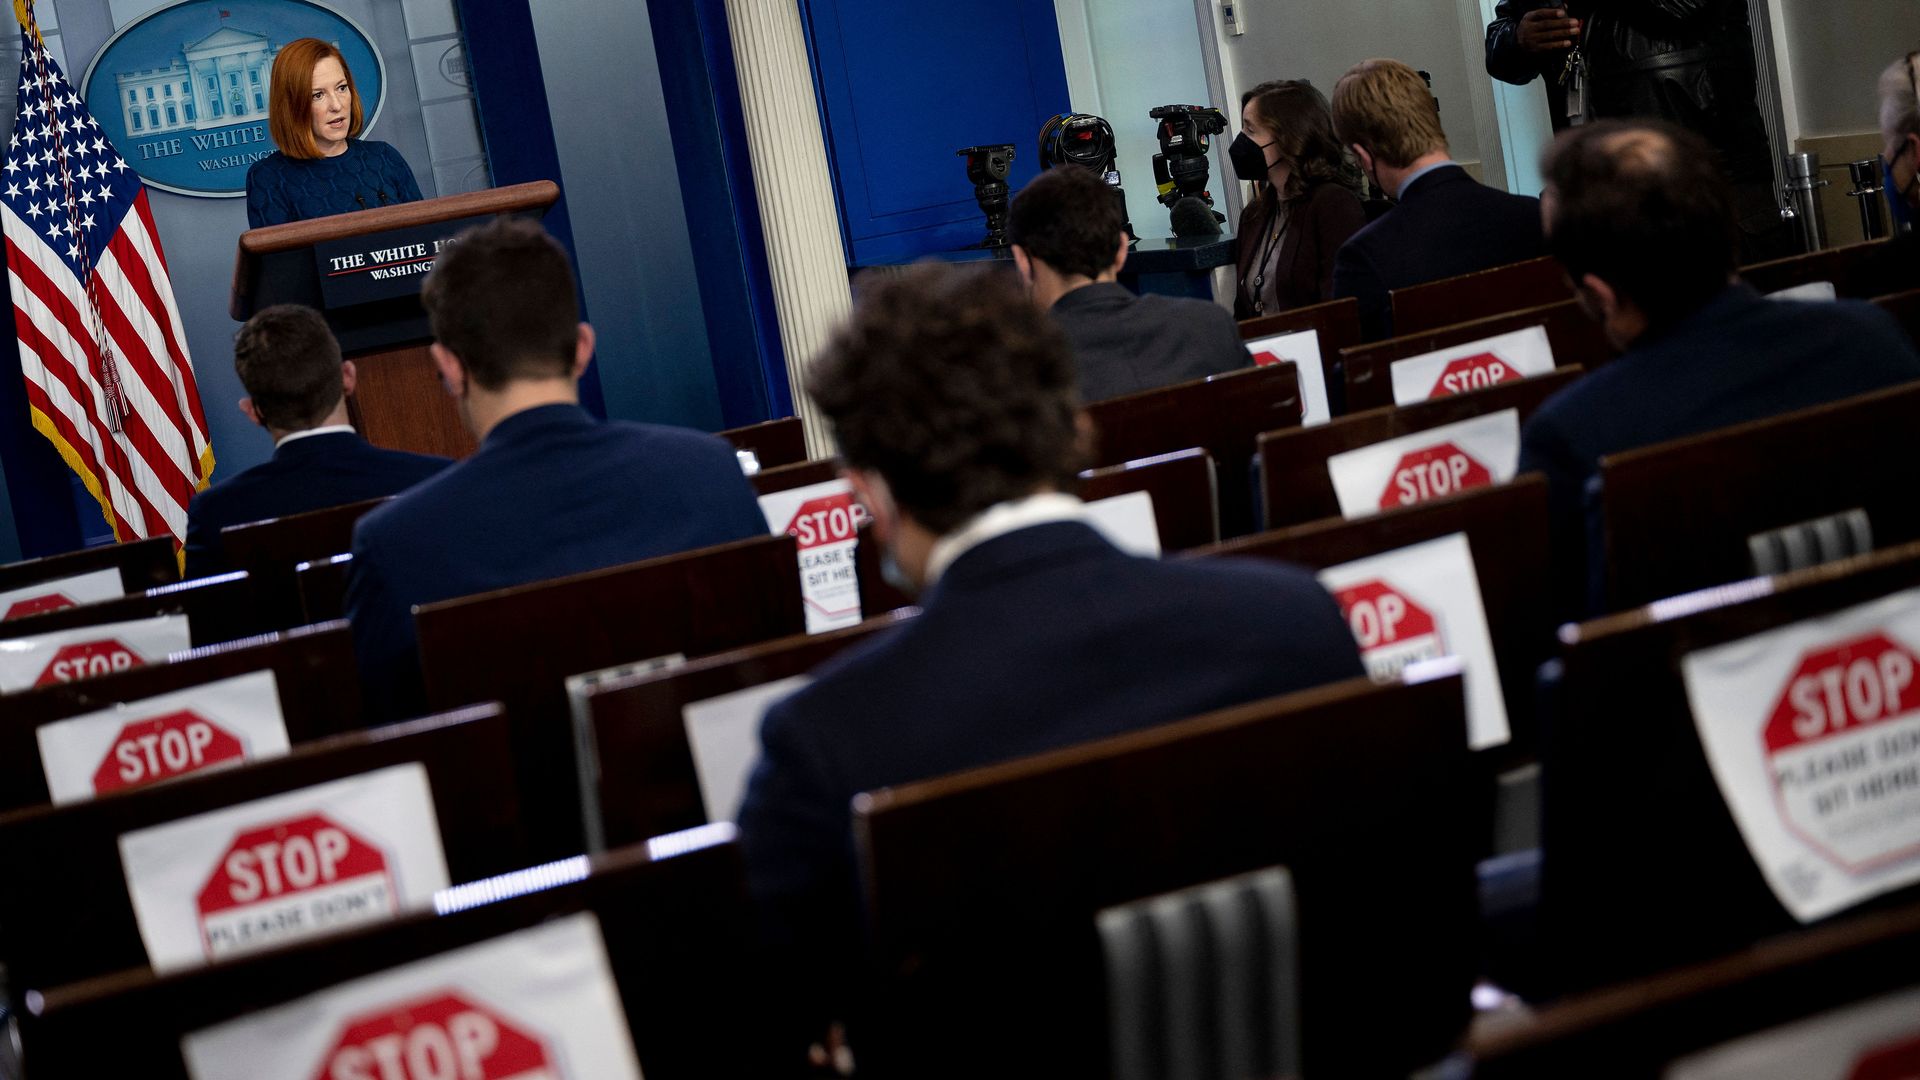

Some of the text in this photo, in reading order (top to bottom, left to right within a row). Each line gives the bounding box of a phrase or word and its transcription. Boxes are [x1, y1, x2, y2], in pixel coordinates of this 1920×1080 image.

[138, 125, 266, 160] THE WHITE
[330, 253, 366, 271] THE
[369, 243, 427, 264] WHITE
[1443, 361, 1505, 394] STOP
[1395, 453, 1469, 505] STOP
[796, 503, 868, 546] STOP
[1349, 592, 1407, 649] OP
[1788, 649, 1914, 739] STOP
[115, 722, 213, 782] STOP
[224, 827, 350, 904] STOP
